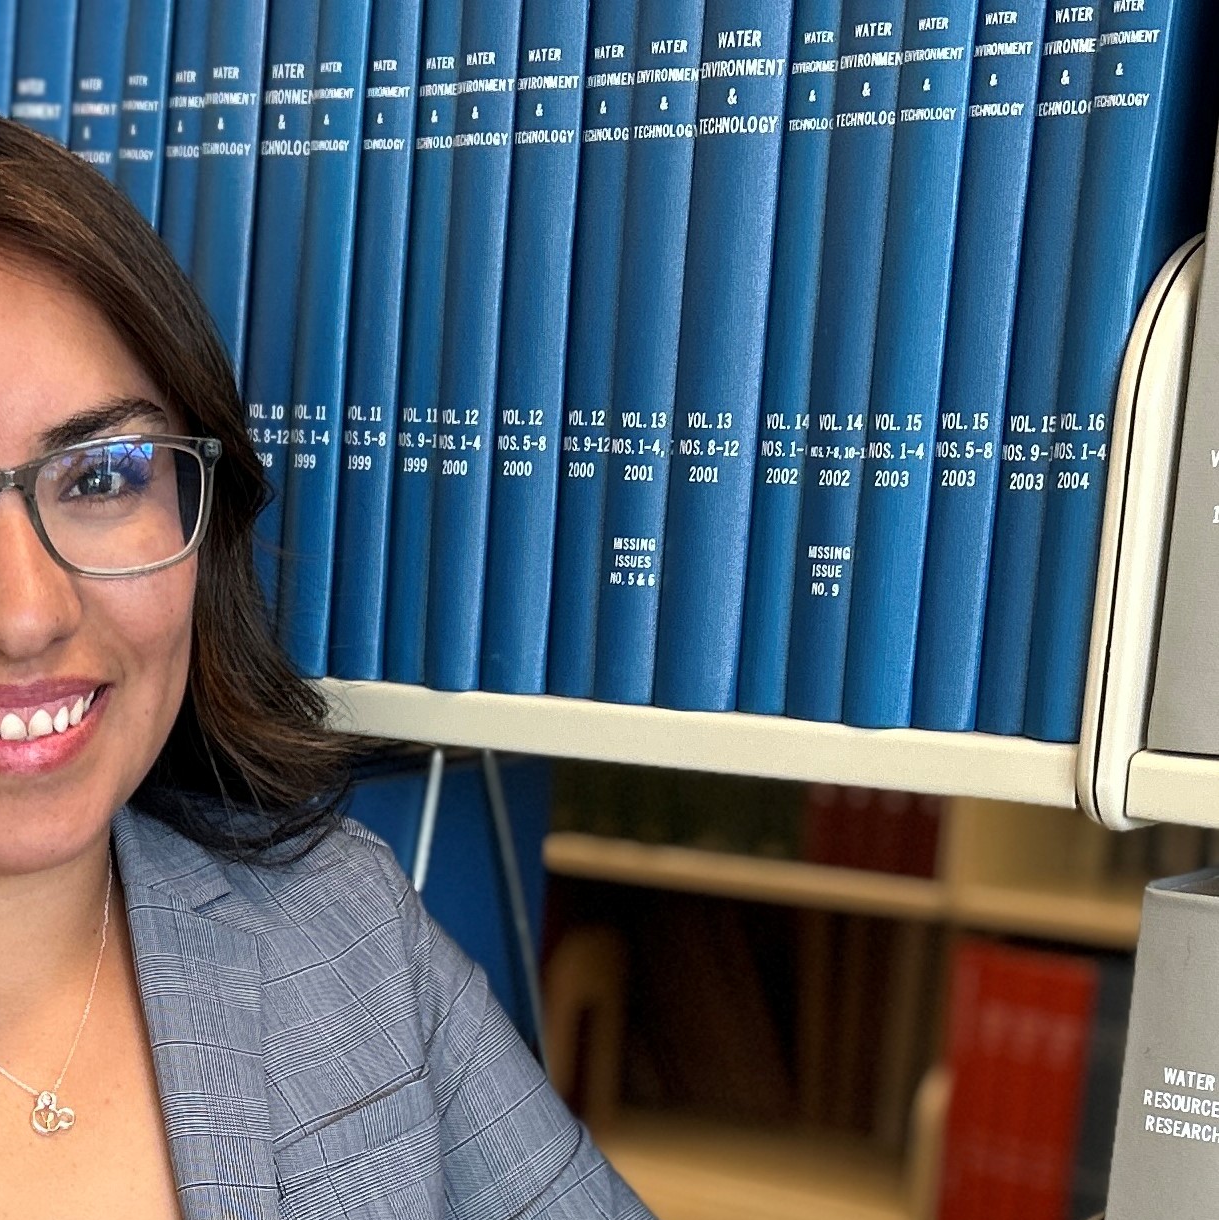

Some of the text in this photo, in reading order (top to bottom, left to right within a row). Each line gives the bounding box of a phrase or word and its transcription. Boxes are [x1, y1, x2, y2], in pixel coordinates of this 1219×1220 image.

[1114, 0, 1144, 13] WATER
[919, 17, 949, 31] WATER
[985, 11, 1017, 25] WATER
[855, 22, 892, 37] WATER
[652, 40, 688, 53] WATER
[718, 30, 761, 48] WATER
[528, 48, 561, 62] WATER
[904, 47, 964, 62] ENVIRONMENT
[272, 63, 304, 79] WATER
[427, 57, 454, 70] WATER
[702, 58, 786, 79] ENVIRONMENT
[1115, 63, 1123, 76] &
[862, 82, 871, 96] &
[923, 78, 930, 91] &
[728, 88, 737, 105] &
[1094, 94, 1150, 108] TECHNOLOGY
[536, 104, 543, 116] &
[901, 107, 956, 121] TECHNOLOGY
[700, 116, 778, 135] TECHNOLOGY
[515, 129, 574, 144] TECHNOLOGY
[271, 405, 284, 419] 10
[316, 405, 326, 420] 11
[348, 405, 381, 421] VOL. 11
[426, 408, 437, 422] 11
[443, 409, 479, 425] VOL. 12
[503, 410, 543, 425] VOL. 12
[569, 410, 605, 426] VOL. 12
[622, 412, 666, 428] VOL. 13
[688, 412, 732, 429] VOL. 13
[766, 413, 809, 430] VOL. 14
[819, 414, 863, 430] VOL. 14
[875, 414, 922, 431] VOL. 15
[942, 413, 989, 430] VOL. 15
[1011, 416, 1036, 432] VOL.
[1061, 414, 1105, 431] VOL. 16
[311, 429, 329, 445] 1-4
[364, 431, 386, 446] 5-8
[460, 435, 481, 450] 1-4
[498, 435, 546, 451] NOS. 5-8
[584, 437, 610, 452] 9-12
[612, 439, 635, 455] NOS.
[680, 440, 739, 457] NOS. 8-12
[761, 441, 785, 457] NOS.
[869, 442, 924, 459] NOS. 1-4
[936, 442, 992, 459] NOS. 5-8
[1081, 443, 1106, 460] 1-4
[294, 454, 316, 468] 1999
[348, 455, 371, 470] 1999
[403, 457, 427, 472] 1999
[442, 460, 467, 475] 2000
[503, 461, 532, 476] 2000
[568, 462, 594, 478] 2000
[624, 465, 653, 481] 2001
[689, 466, 718, 482] 2001
[766, 468, 798, 484] 2002
[819, 470, 850, 486] 2002
[942, 470, 975, 486] 2003
[875, 471, 909, 487] 2003
[1010, 473, 1043, 490] 2003
[1057, 472, 1089, 489] 2004
[614, 538, 656, 551] MISSING
[808, 546, 850, 560] MISSING
[615, 555, 651, 568] ISSUES
[628, 573, 634, 585] 5
[637, 573, 645, 586] &
[647, 574, 655, 586] 6
[812, 565, 842, 578] ISSUE
[832, 584, 839, 596] 9
[1164, 1067, 1215, 1091] WATER
[1143, 1089, 1219, 1118] RESOURCE
